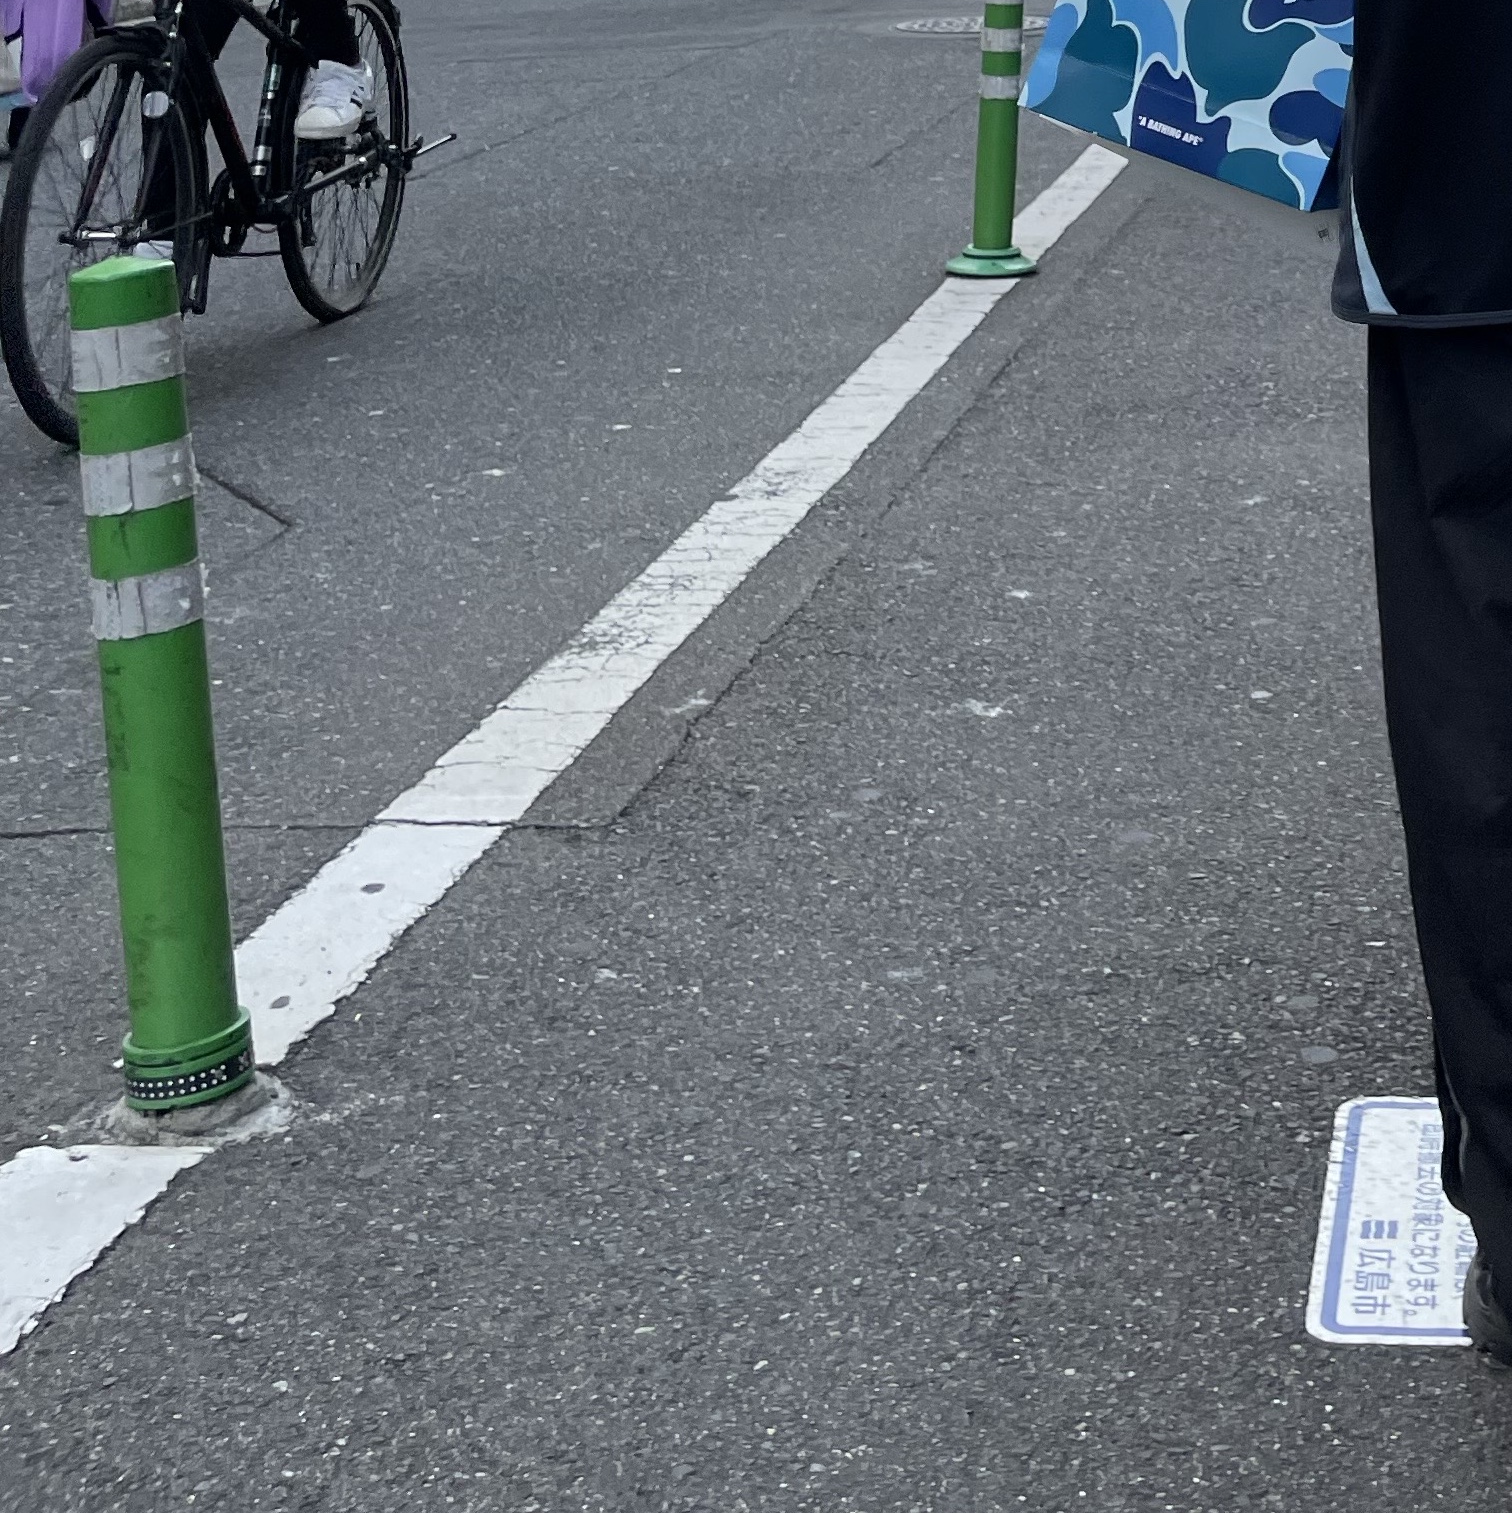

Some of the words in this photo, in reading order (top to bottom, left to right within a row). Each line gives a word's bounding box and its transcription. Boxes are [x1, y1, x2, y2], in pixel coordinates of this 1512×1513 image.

[1147, 119, 1182, 139] BATHING
[1351, 1248, 1396, 1316] 広島市
